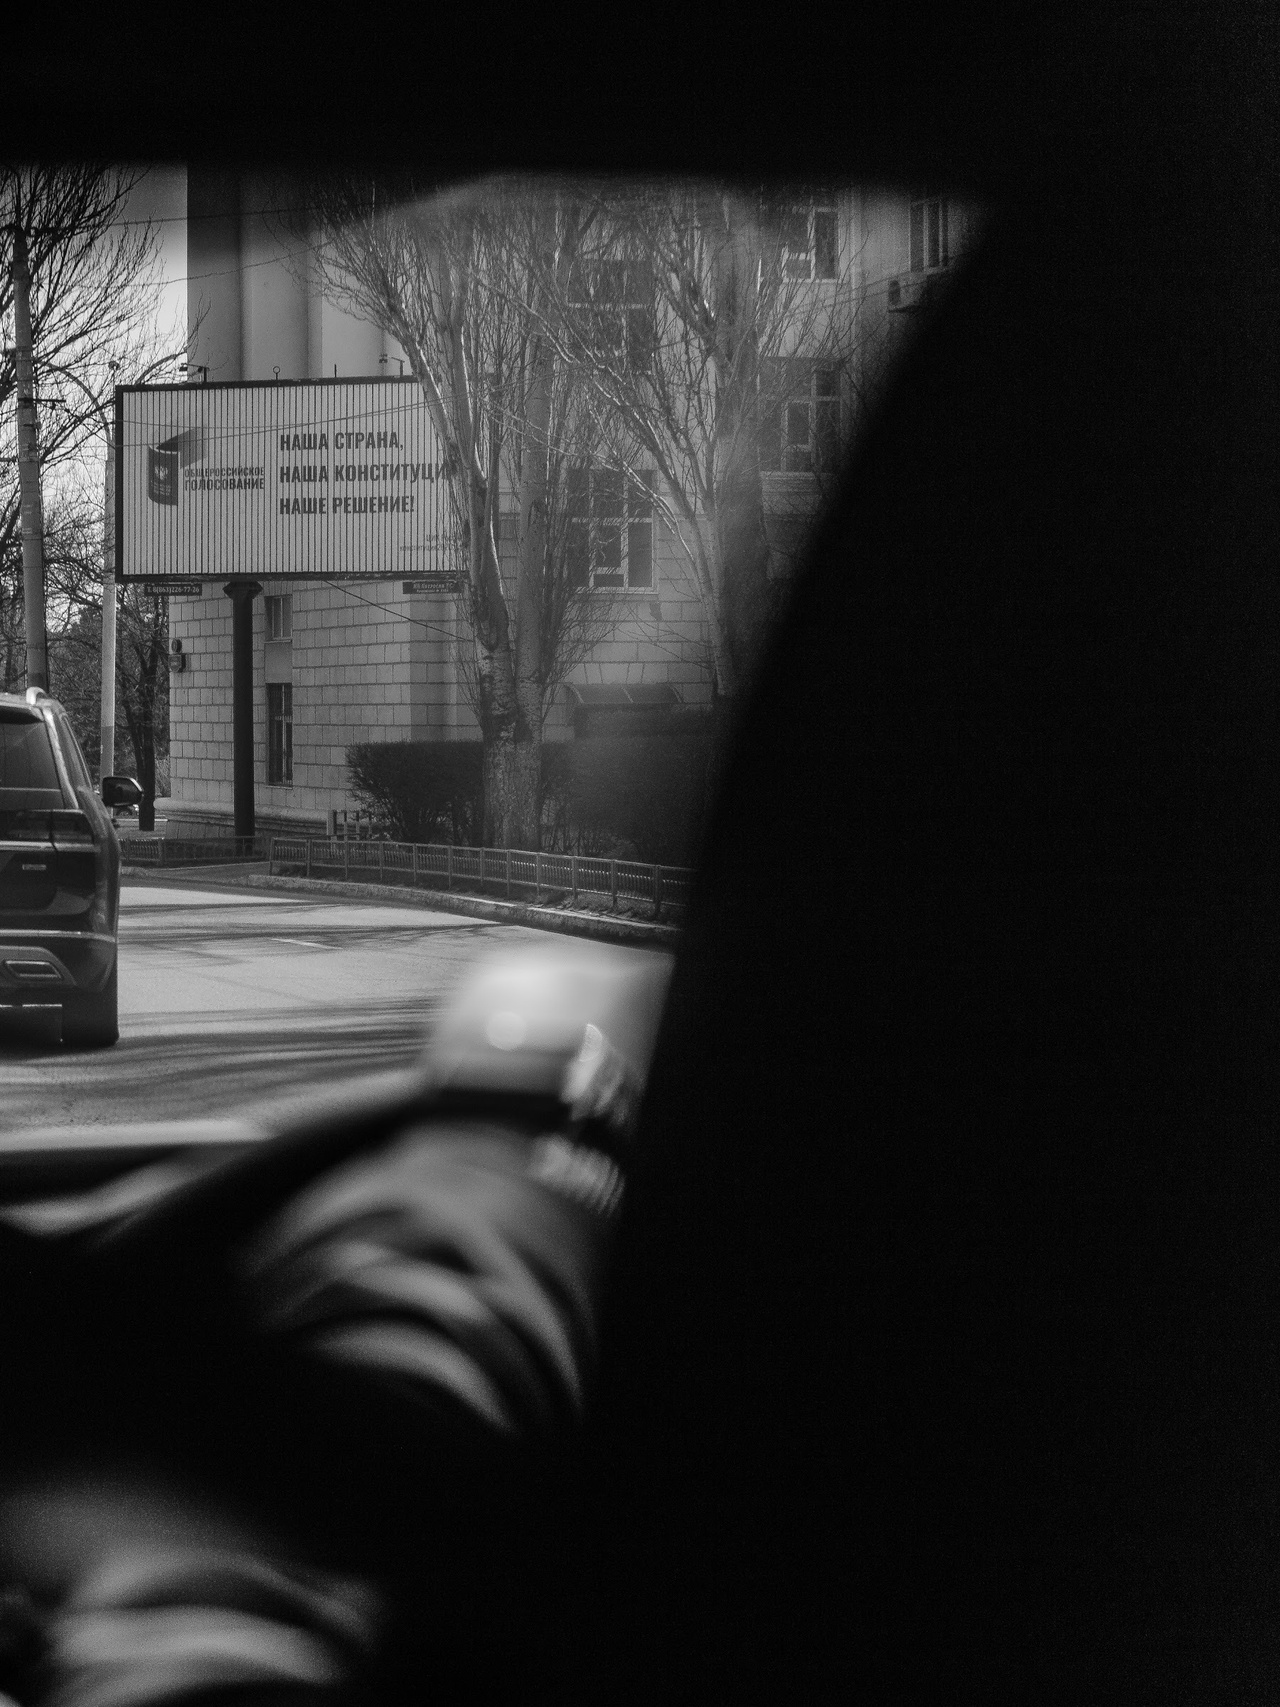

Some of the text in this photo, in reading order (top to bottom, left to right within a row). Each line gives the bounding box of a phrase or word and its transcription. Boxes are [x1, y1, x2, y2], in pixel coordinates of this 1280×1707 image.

[280, 431, 404, 451] НАША СТРАНА,
[184, 466, 265, 479] ОБЩЕРОССИЙСКОЕ
[280, 463, 451, 484] НАША КОНСТИТУЦИ
[184, 478, 265, 491] ГОЛОСОВАНИЕ
[280, 495, 415, 515] НАШЕ РЕШЕНИЕ!
